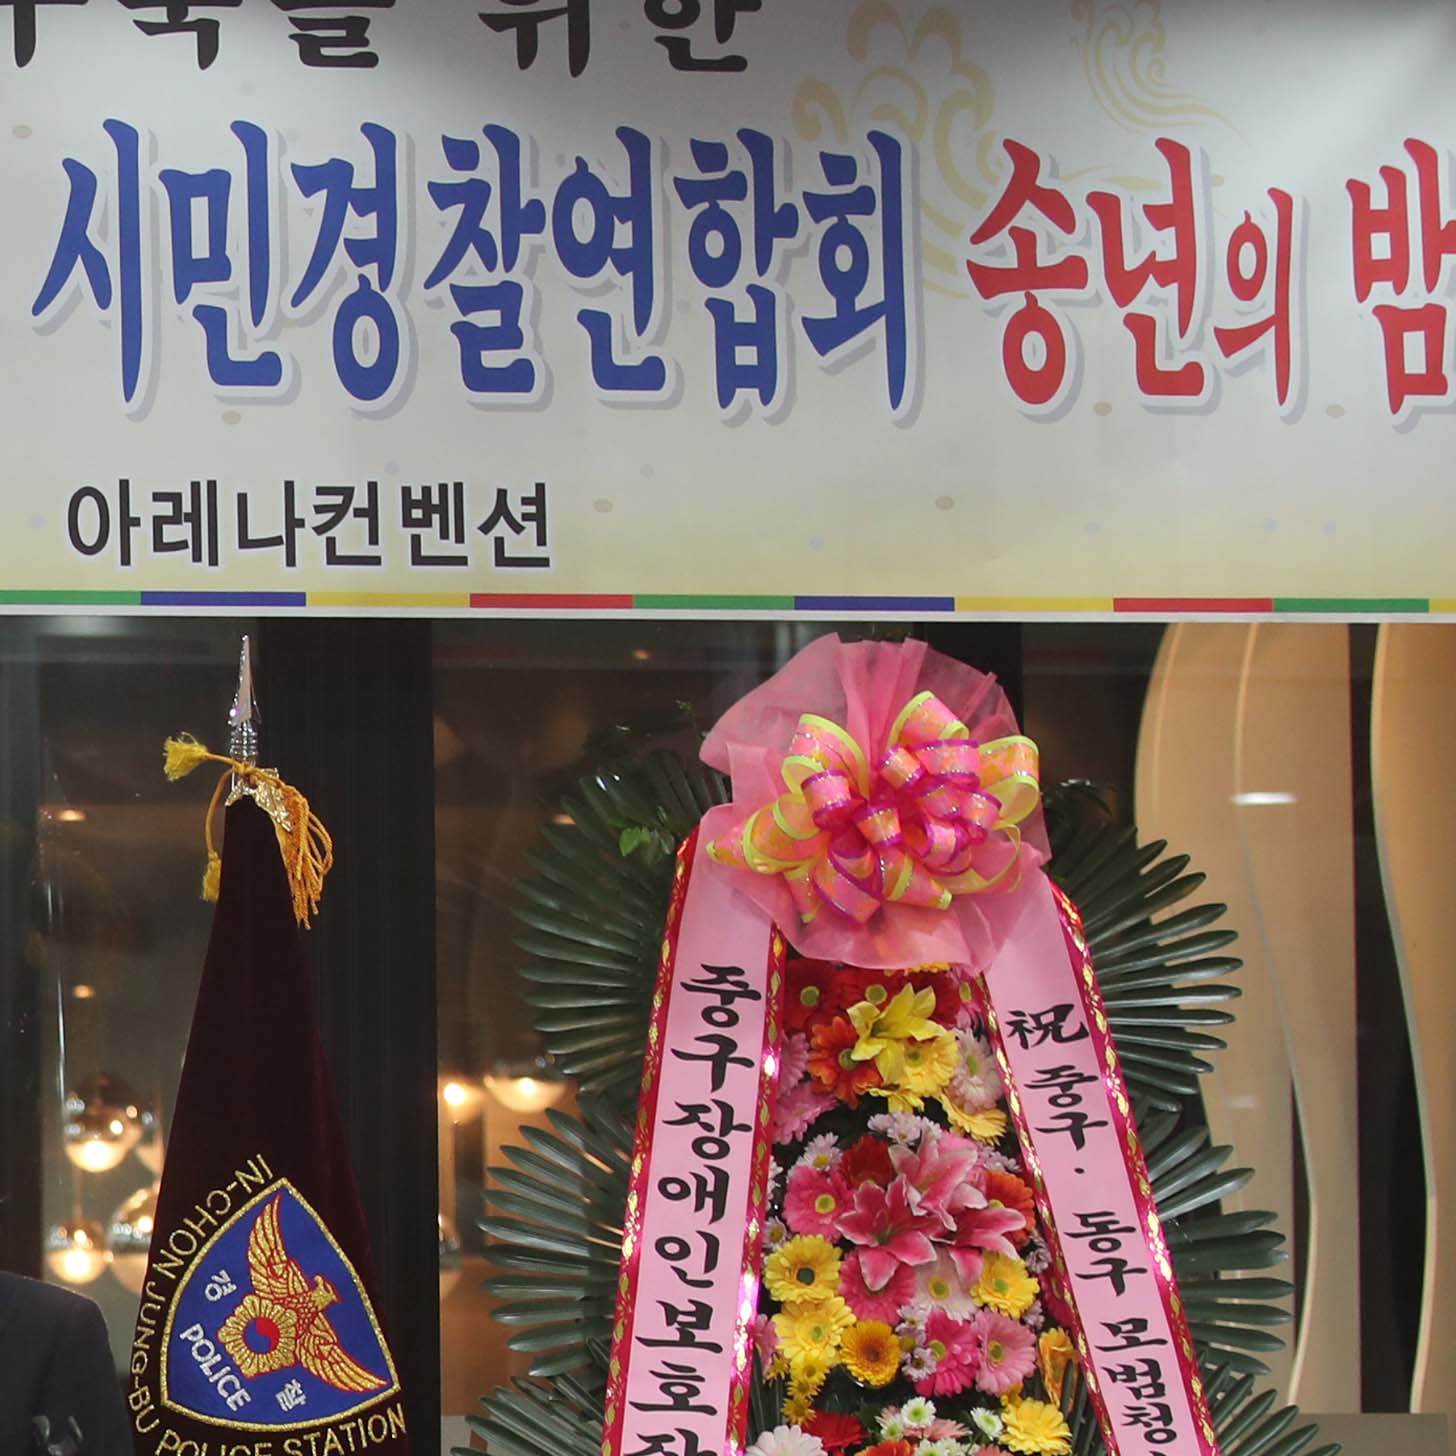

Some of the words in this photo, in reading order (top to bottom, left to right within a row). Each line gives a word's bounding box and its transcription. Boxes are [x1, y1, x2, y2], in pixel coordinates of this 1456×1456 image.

[32, 119, 907, 410] 시민경찰연합회
[966, 138, 1293, 406] 송년의
[1346, 139, 1456, 413] 밤
[66, 478, 552, 568] 아레나컨벤션
[1006, 1002, 1090, 1051] 祝
[152, 1153, 273, 1280] IN-CHON
[204, 1269, 237, 1302] 경
[128, 1281, 166, 1434] JUNG-BU
[179, 1322, 252, 1412] POLICE
[275, 1378, 307, 1413] 찰
